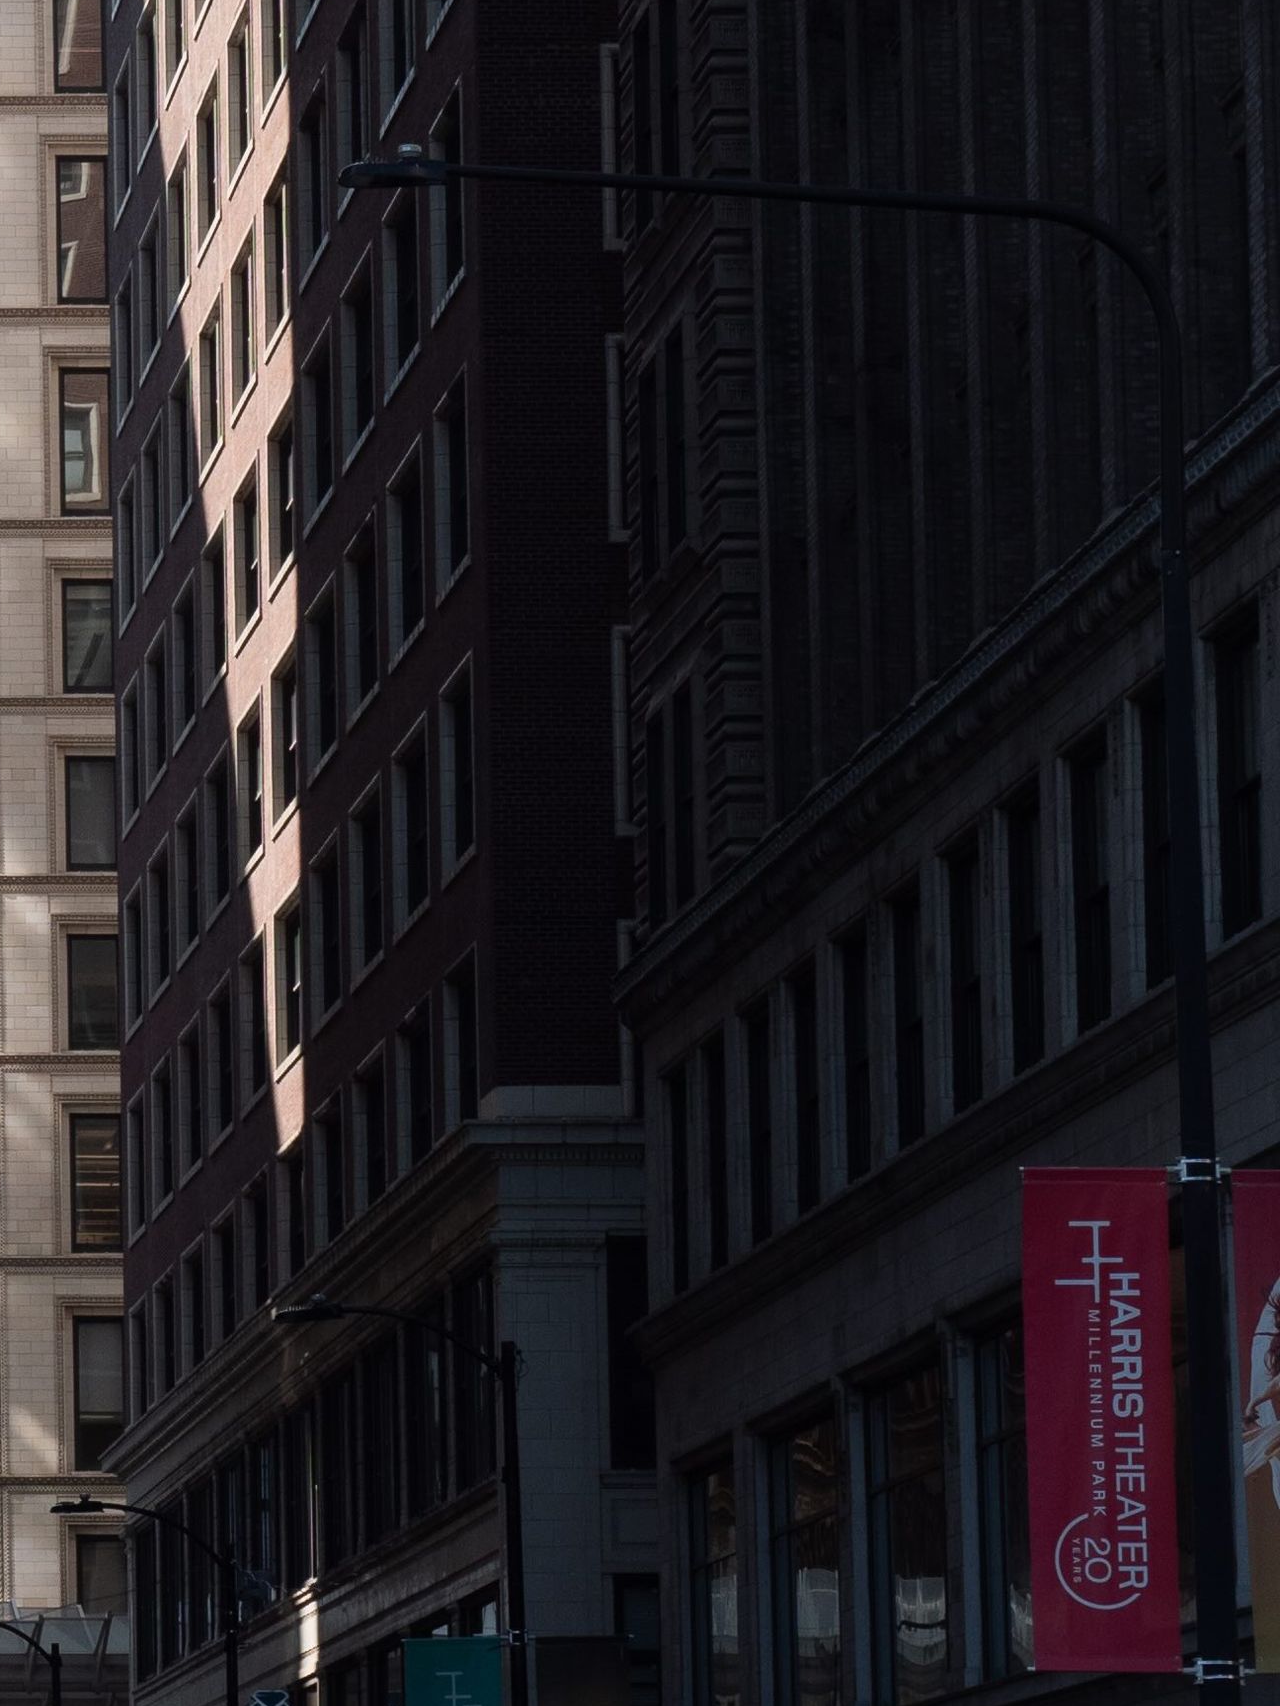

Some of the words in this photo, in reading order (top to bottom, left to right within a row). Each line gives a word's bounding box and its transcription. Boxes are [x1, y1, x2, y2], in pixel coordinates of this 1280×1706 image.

[1087, 1308, 1104, 1448] MILLENNIUM
[1108, 1271, 1145, 1418] HARRIS
[1091, 1460, 1108, 1517] PARK
[1113, 1423, 1149, 1590] THEATER
[1072, 1536, 1082, 1584] YEARS
[1083, 1536, 1112, 1584] 20
